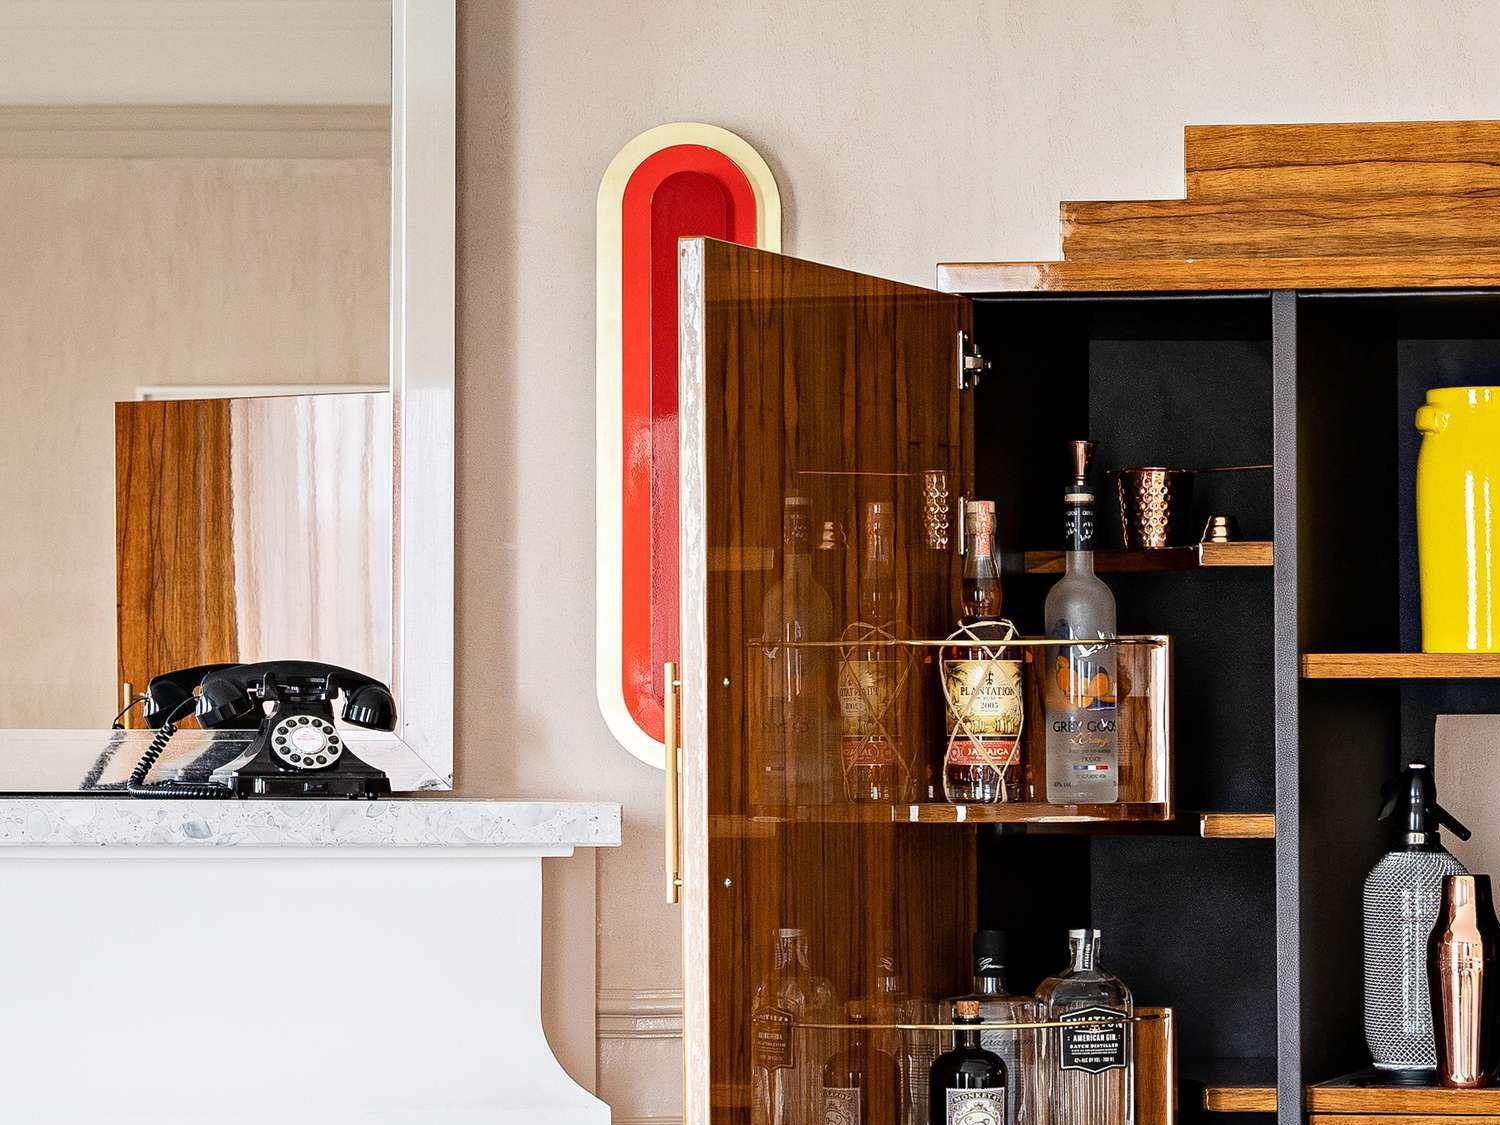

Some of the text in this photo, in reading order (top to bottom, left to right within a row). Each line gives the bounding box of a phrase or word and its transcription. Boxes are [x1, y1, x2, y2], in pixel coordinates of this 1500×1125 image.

[960, 686, 1016, 696] PLANTATION
[967, 747, 1009, 756] JAAICA
[1073, 1034, 1105, 1042] AMERICAN
